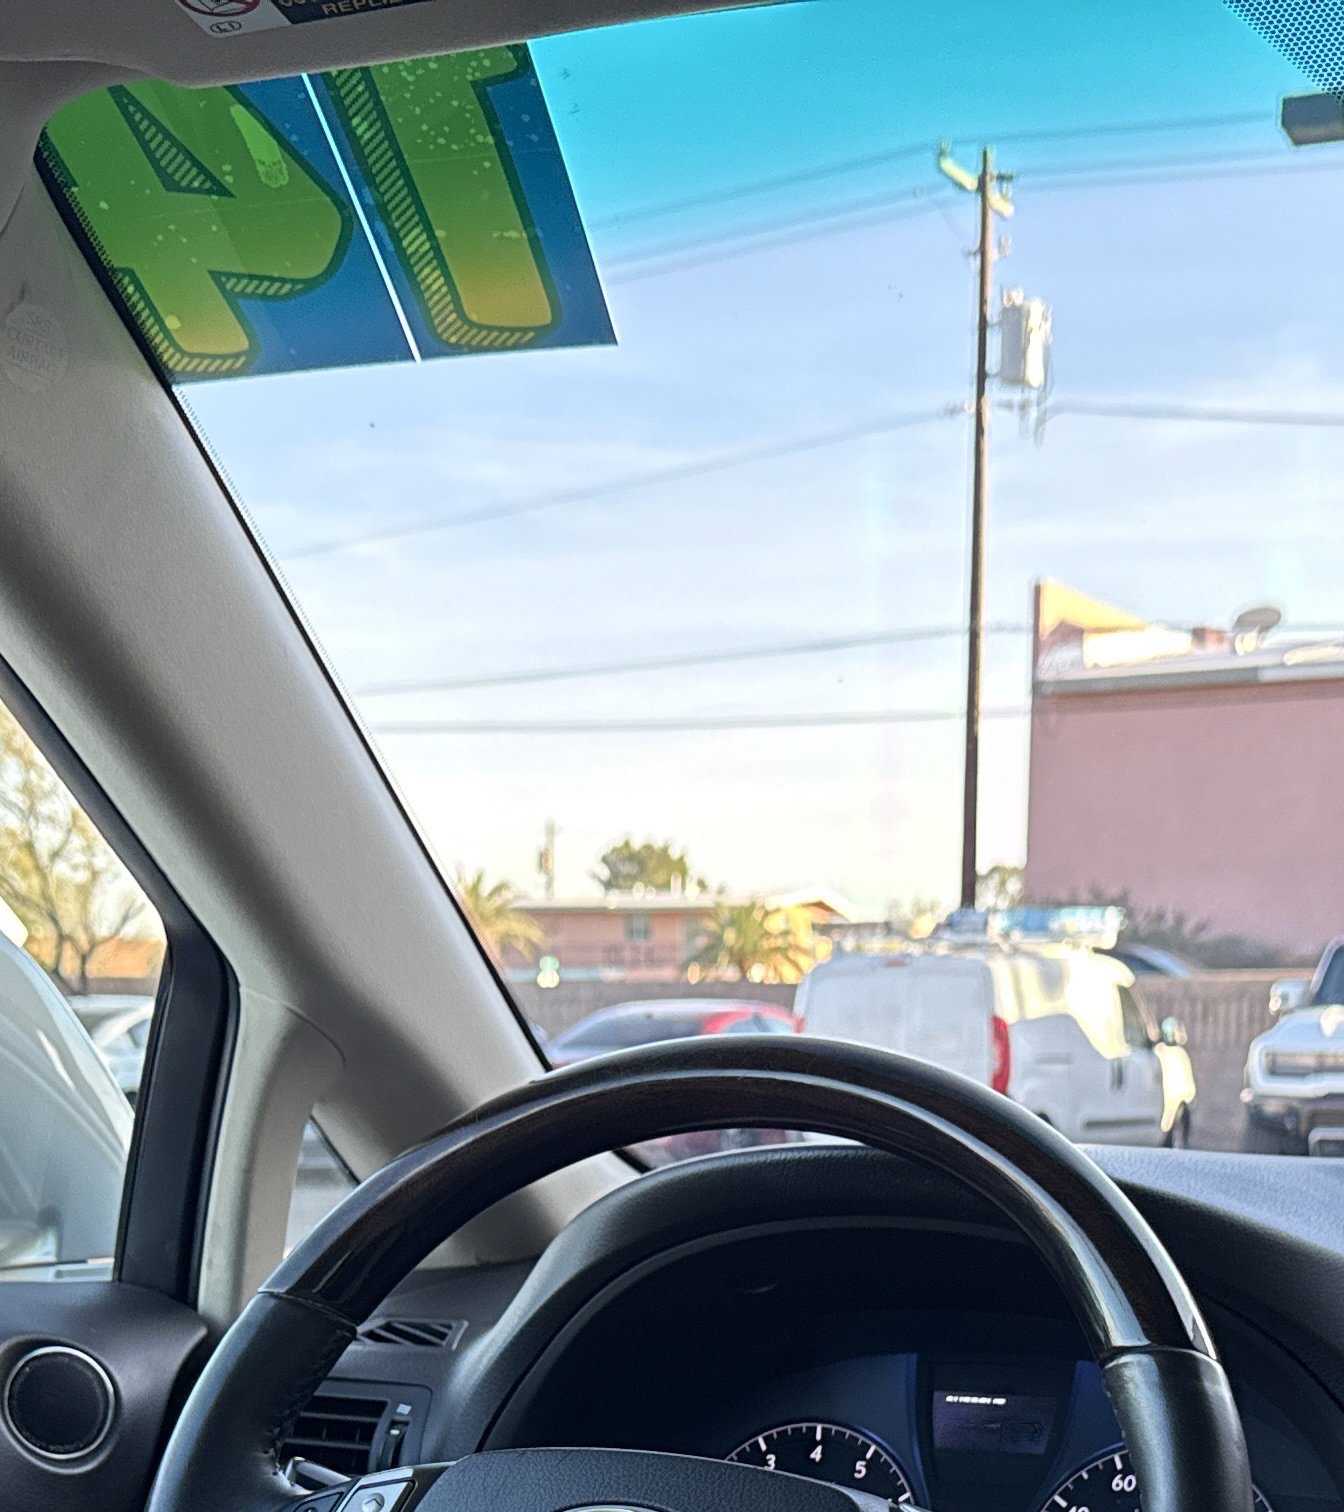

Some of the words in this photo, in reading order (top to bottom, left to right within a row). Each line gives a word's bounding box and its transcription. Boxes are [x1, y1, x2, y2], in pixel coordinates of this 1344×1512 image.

[764, 1453, 776, 1470] 3
[810, 1445, 823, 1463] 4
[854, 1460, 867, 1478] 5
[1111, 1474, 1136, 1491] 60
